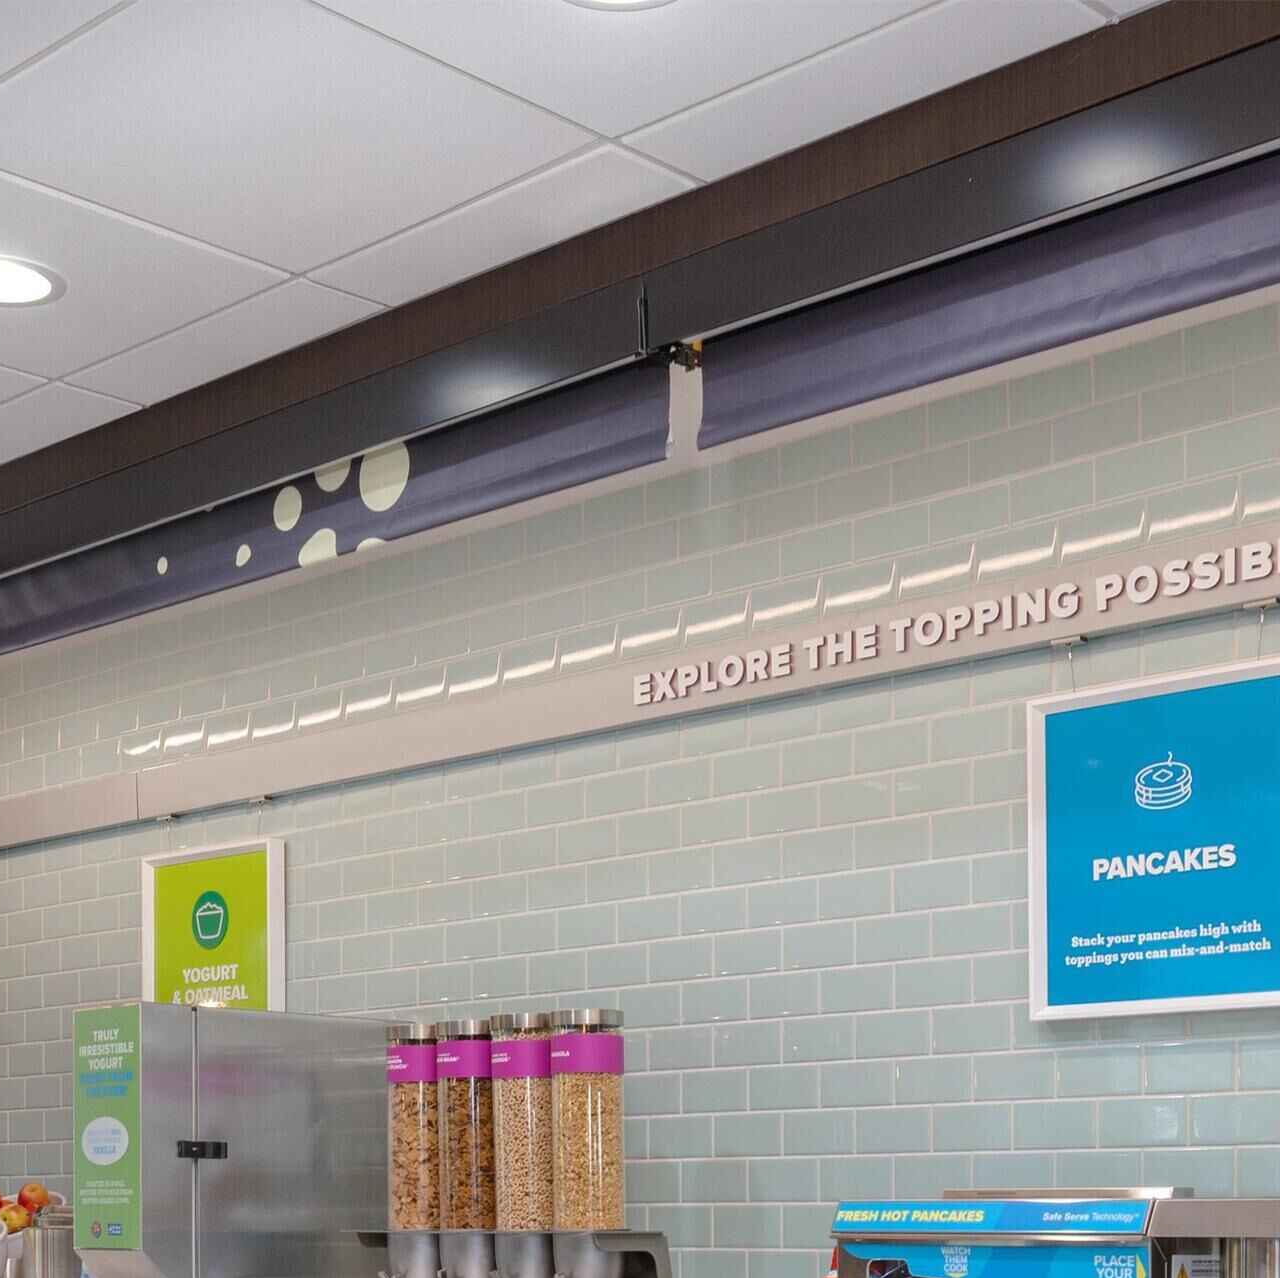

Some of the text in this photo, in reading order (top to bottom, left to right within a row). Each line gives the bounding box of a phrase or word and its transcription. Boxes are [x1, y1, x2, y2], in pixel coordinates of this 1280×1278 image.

[633, 643, 793, 706] EXPLORE
[803, 624, 880, 670] THE
[889, 582, 1081, 653] TOPPING
[1092, 843, 1237, 881] PANCAKES
[1071, 919, 1261, 947] Stack your pancakes high with
[1065, 937, 1271, 967] toppings you can mix-and-match
[182, 964, 239, 984] YOGURT
[173, 985, 248, 1004] & OATMEAL
[93, 1028, 119, 1042] TRULY
[79, 1041, 134, 1056] IRRESISTIBLE
[89, 1056, 123, 1070] YOGURT
[836, 1210, 985, 1222] FRESH HOT PANCAKES
[1043, 1212, 1062, 1221] Safe
[1064, 1212, 1089, 1221] Serve
[941, 1246, 971, 1256] WATCH
[944, 1255, 967, 1264] THEM
[1094, 1255, 1135, 1267] PLACE
[944, 1263, 968, 1272] COOK
[1096, 1268, 1133, 1278] YOUR
